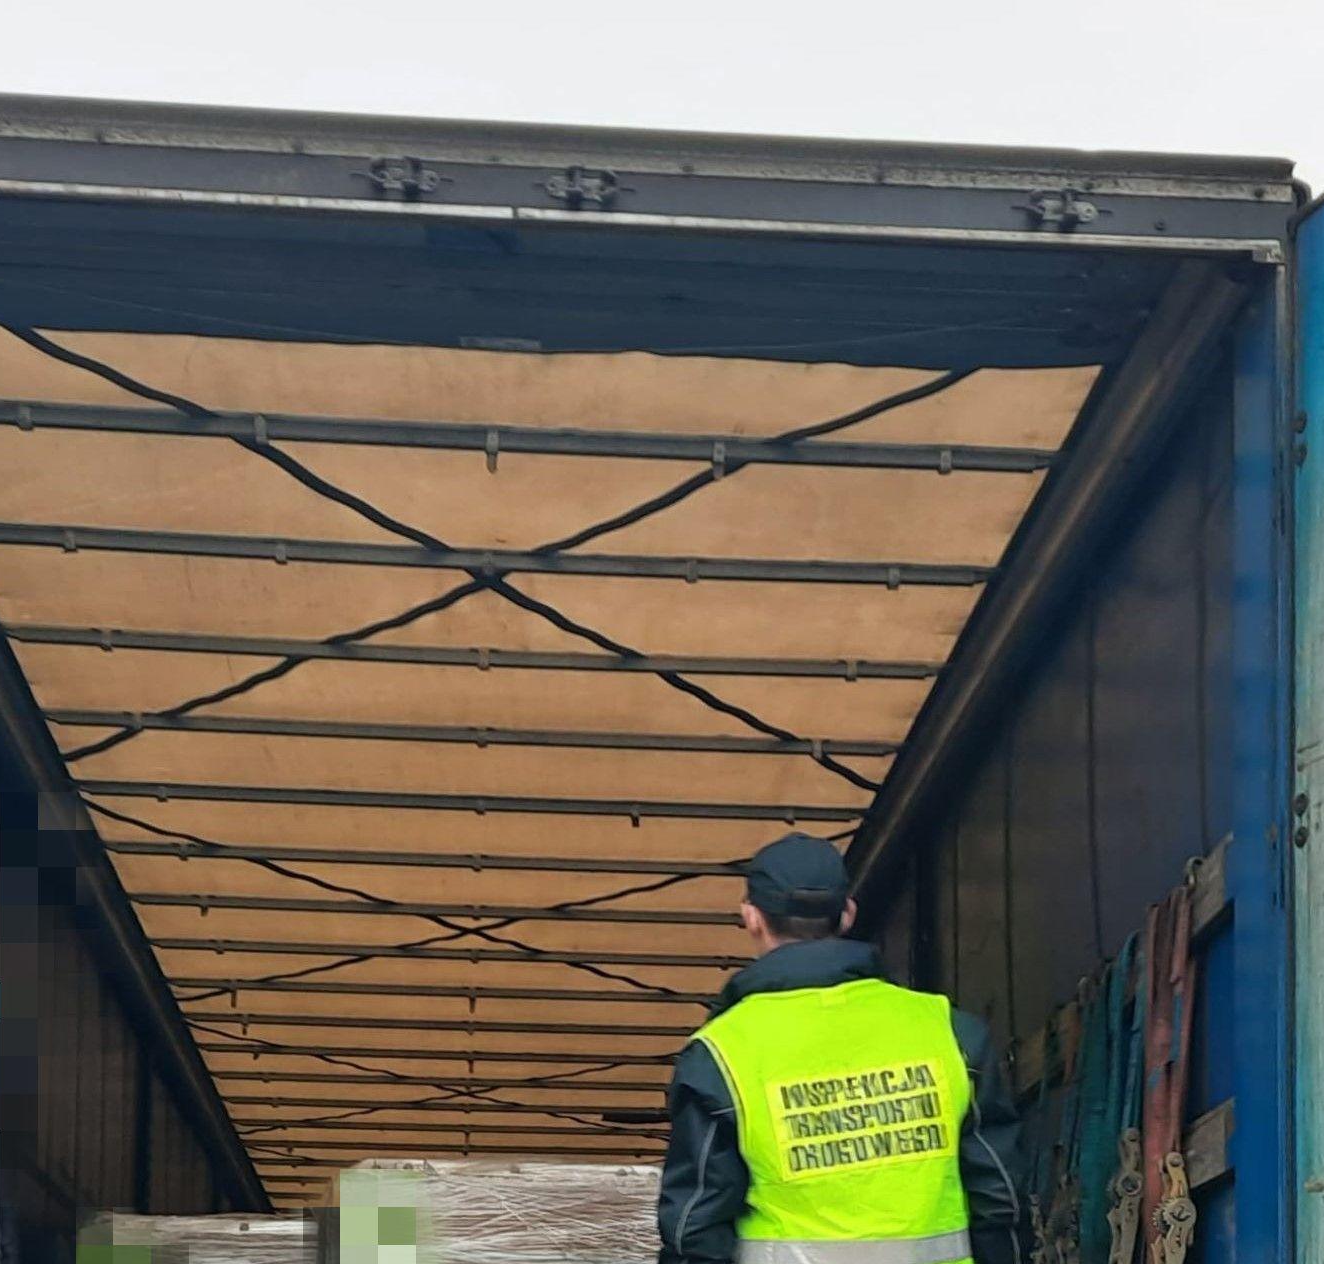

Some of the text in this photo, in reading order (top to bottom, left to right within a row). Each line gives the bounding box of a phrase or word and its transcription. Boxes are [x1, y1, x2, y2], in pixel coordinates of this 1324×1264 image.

[780, 1064, 936, 1109] INSPEKCJA
[782, 1092, 941, 1139] TRANSPORTU
[789, 1124, 948, 1172] DROGOWEGO
